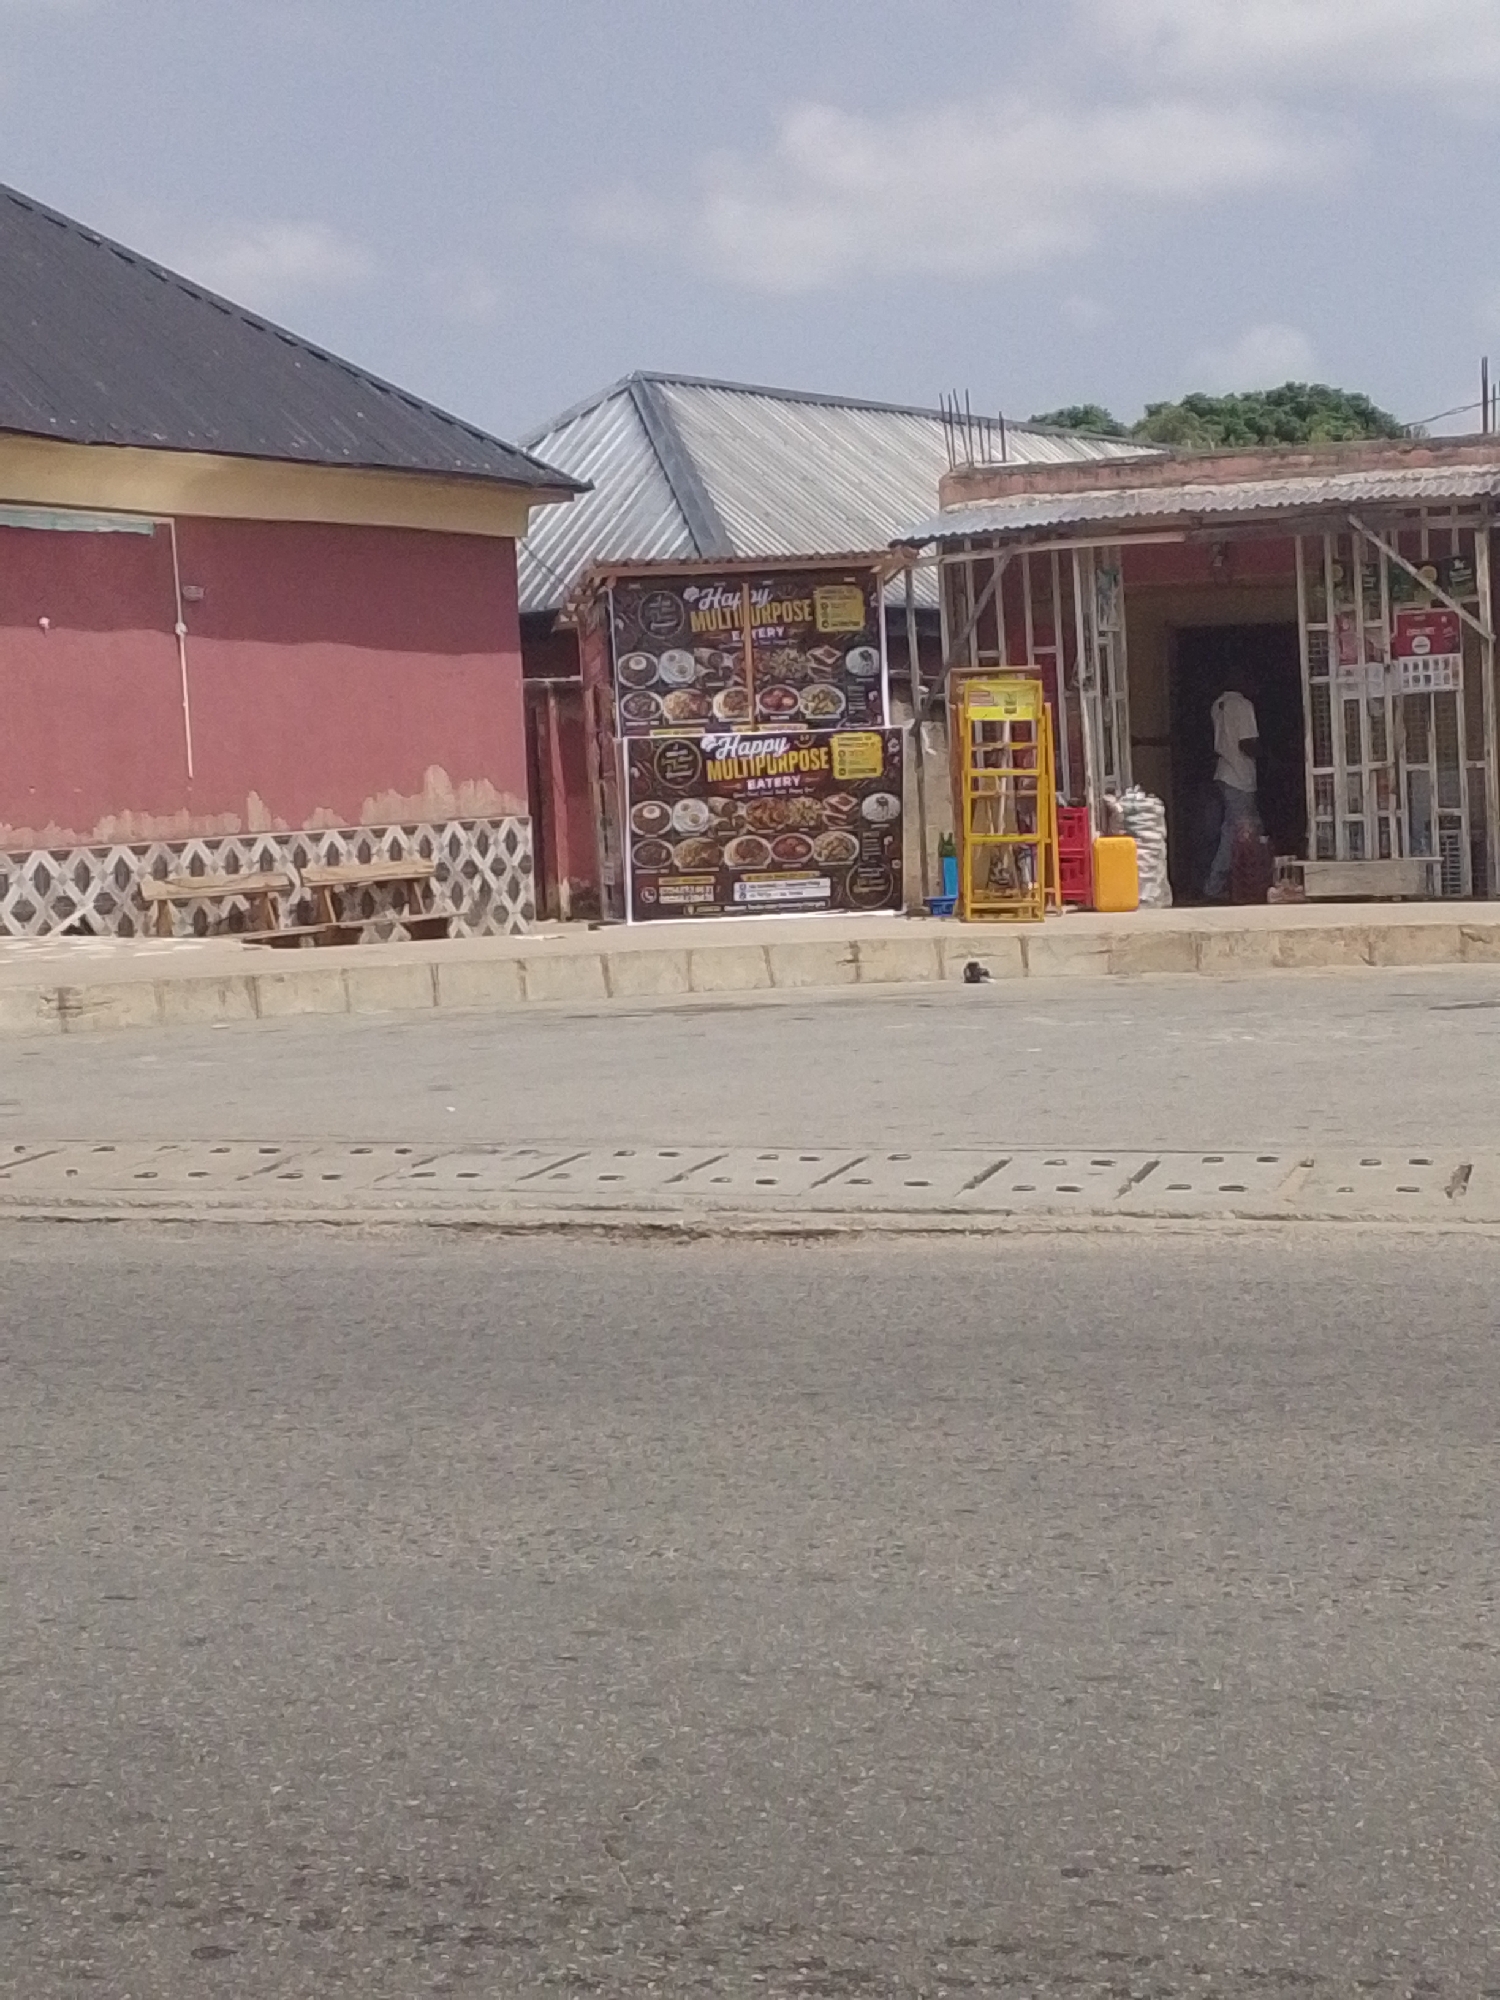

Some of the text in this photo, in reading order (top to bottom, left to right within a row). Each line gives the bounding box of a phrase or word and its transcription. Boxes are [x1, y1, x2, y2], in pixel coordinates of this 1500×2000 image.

[715, 734, 791, 760] Happy
[706, 747, 829, 782] MULTIPURPOSE
[746, 774, 800, 790] EATERY
